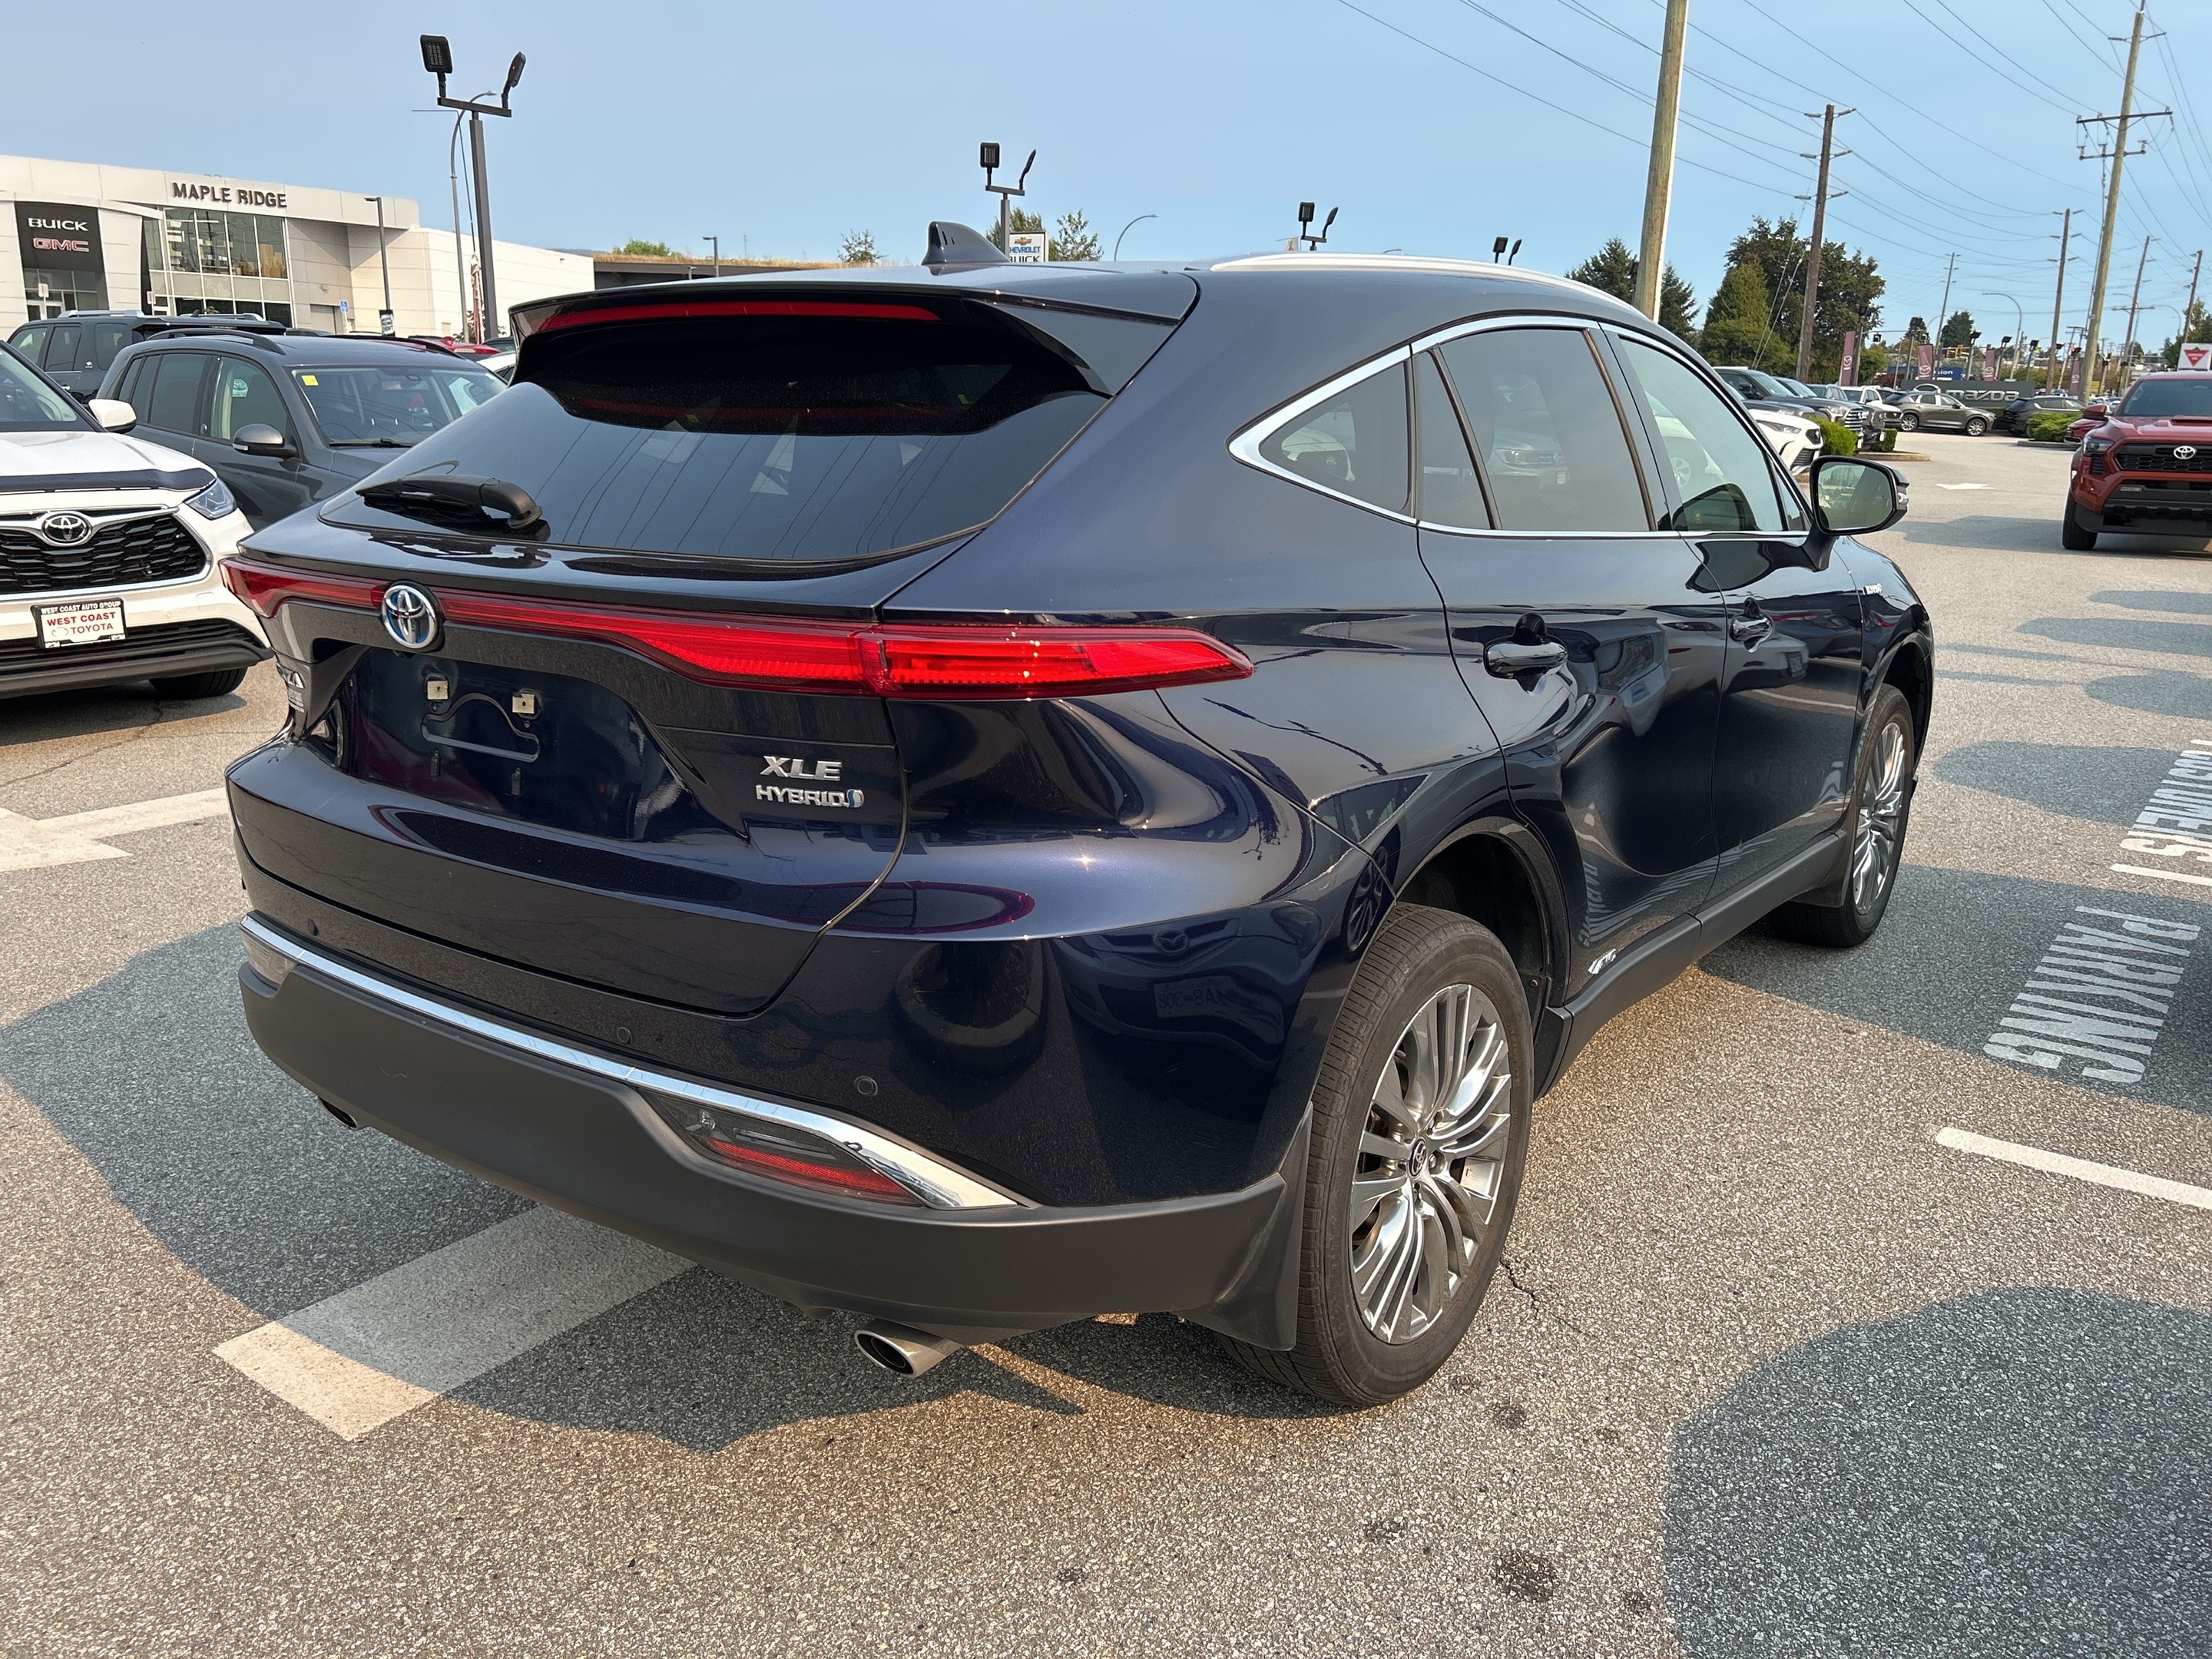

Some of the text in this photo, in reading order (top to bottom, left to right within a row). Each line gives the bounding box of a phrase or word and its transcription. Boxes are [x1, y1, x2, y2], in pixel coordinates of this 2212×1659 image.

[172, 182, 287, 208] MAPLE RIDGE
[28, 217, 88, 231] BUICK
[33, 237, 89, 253] GMC
[41, 606, 59, 614] WEST
[59, 604, 81, 613] COAST
[81, 602, 98, 611] AUTO
[47, 611, 116, 627] WEST COAST
[71, 623, 114, 634] TOYOTA
[760, 755, 842, 782] XLE
[755, 784, 845, 807] HYBRID
[1982, 906, 2201, 1084] PARKING
